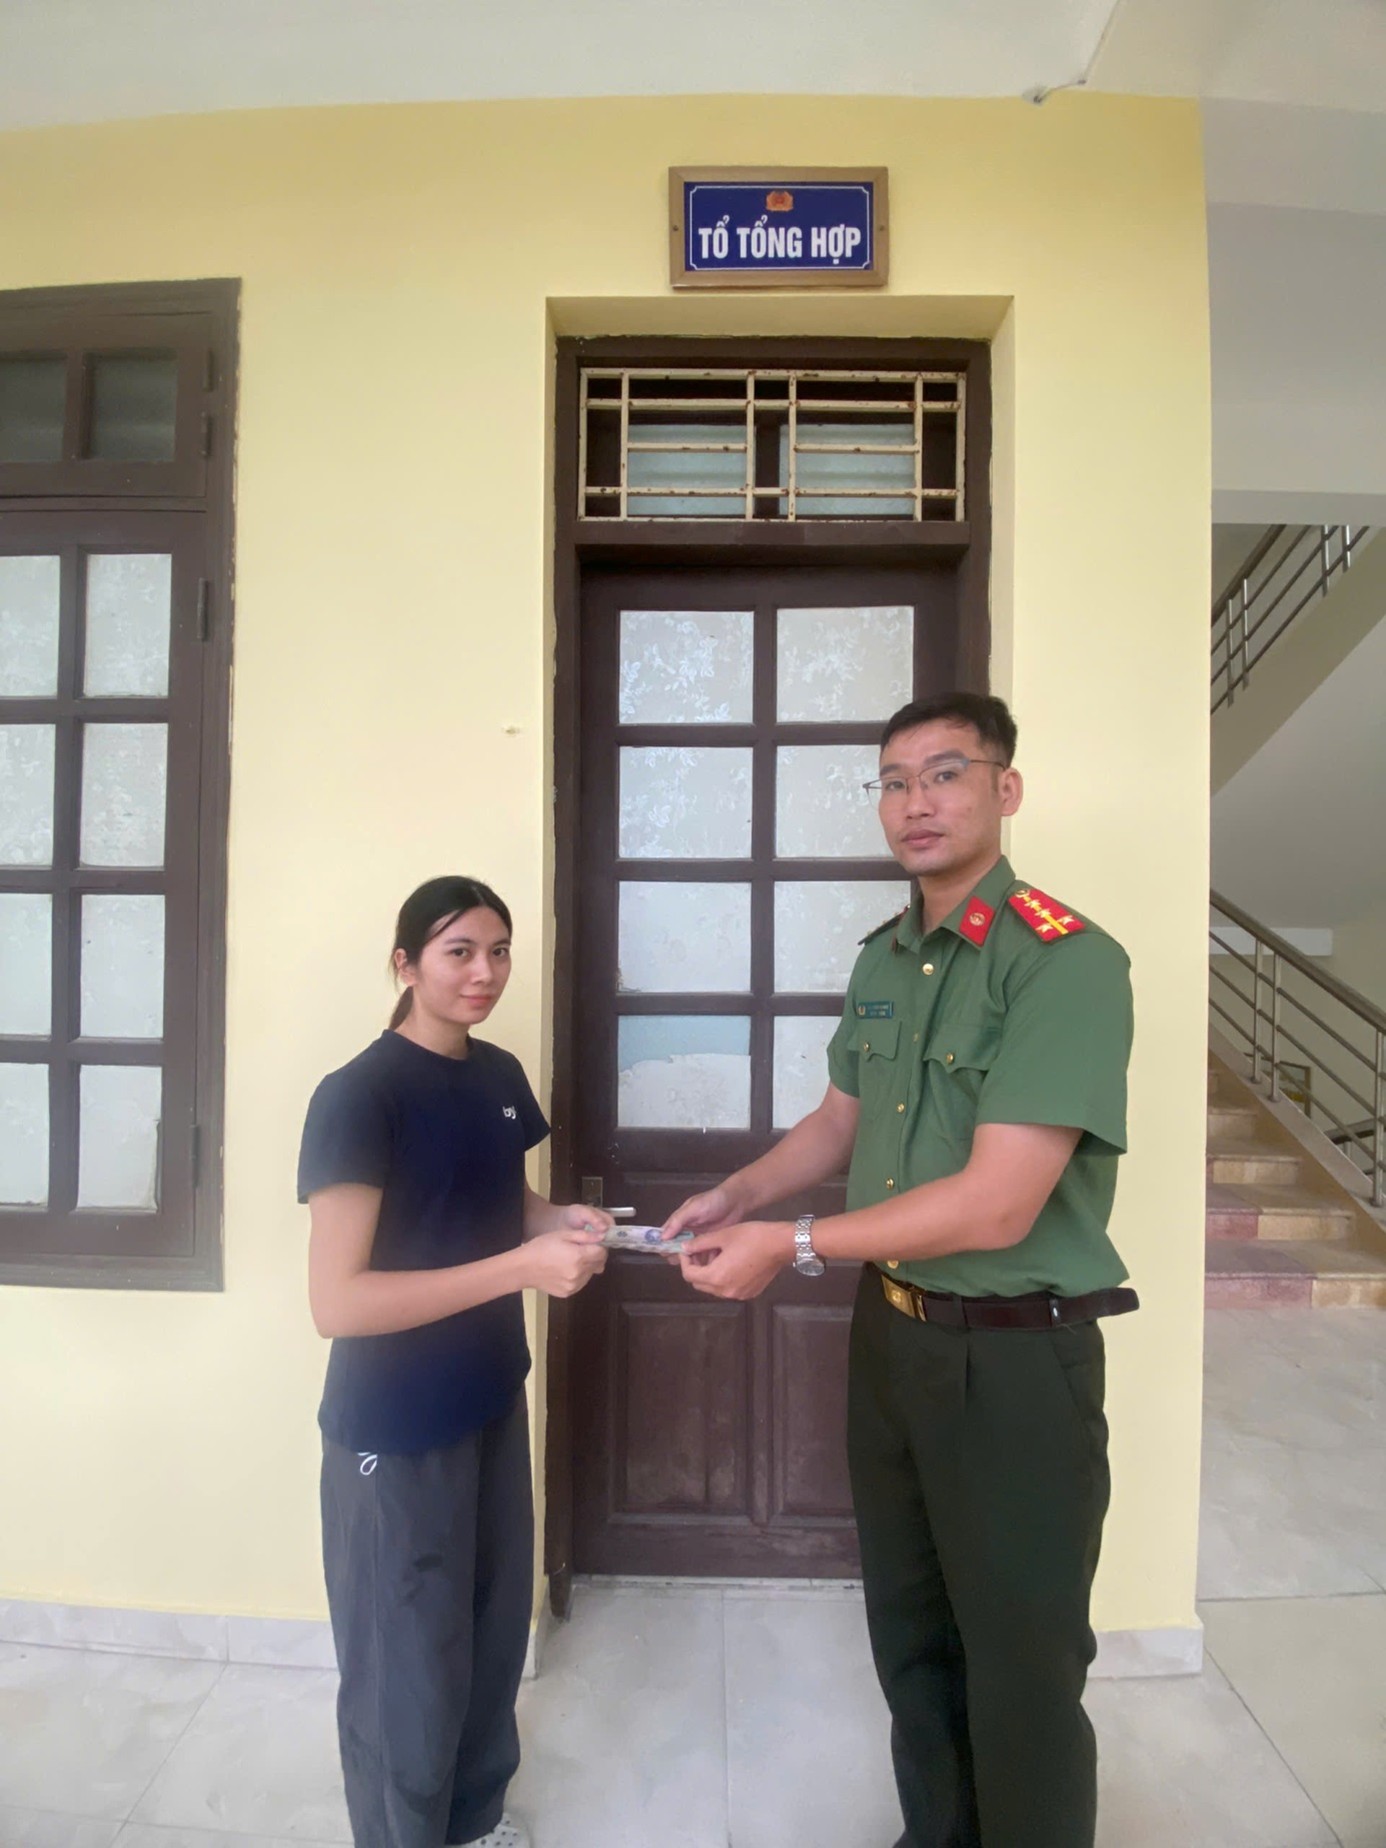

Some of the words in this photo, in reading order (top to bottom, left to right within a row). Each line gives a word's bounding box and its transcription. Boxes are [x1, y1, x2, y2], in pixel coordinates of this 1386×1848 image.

[698, 214, 730, 259] TỔ
[736, 214, 802, 259] TỔNG
[810, 224, 862, 265] HỢP
